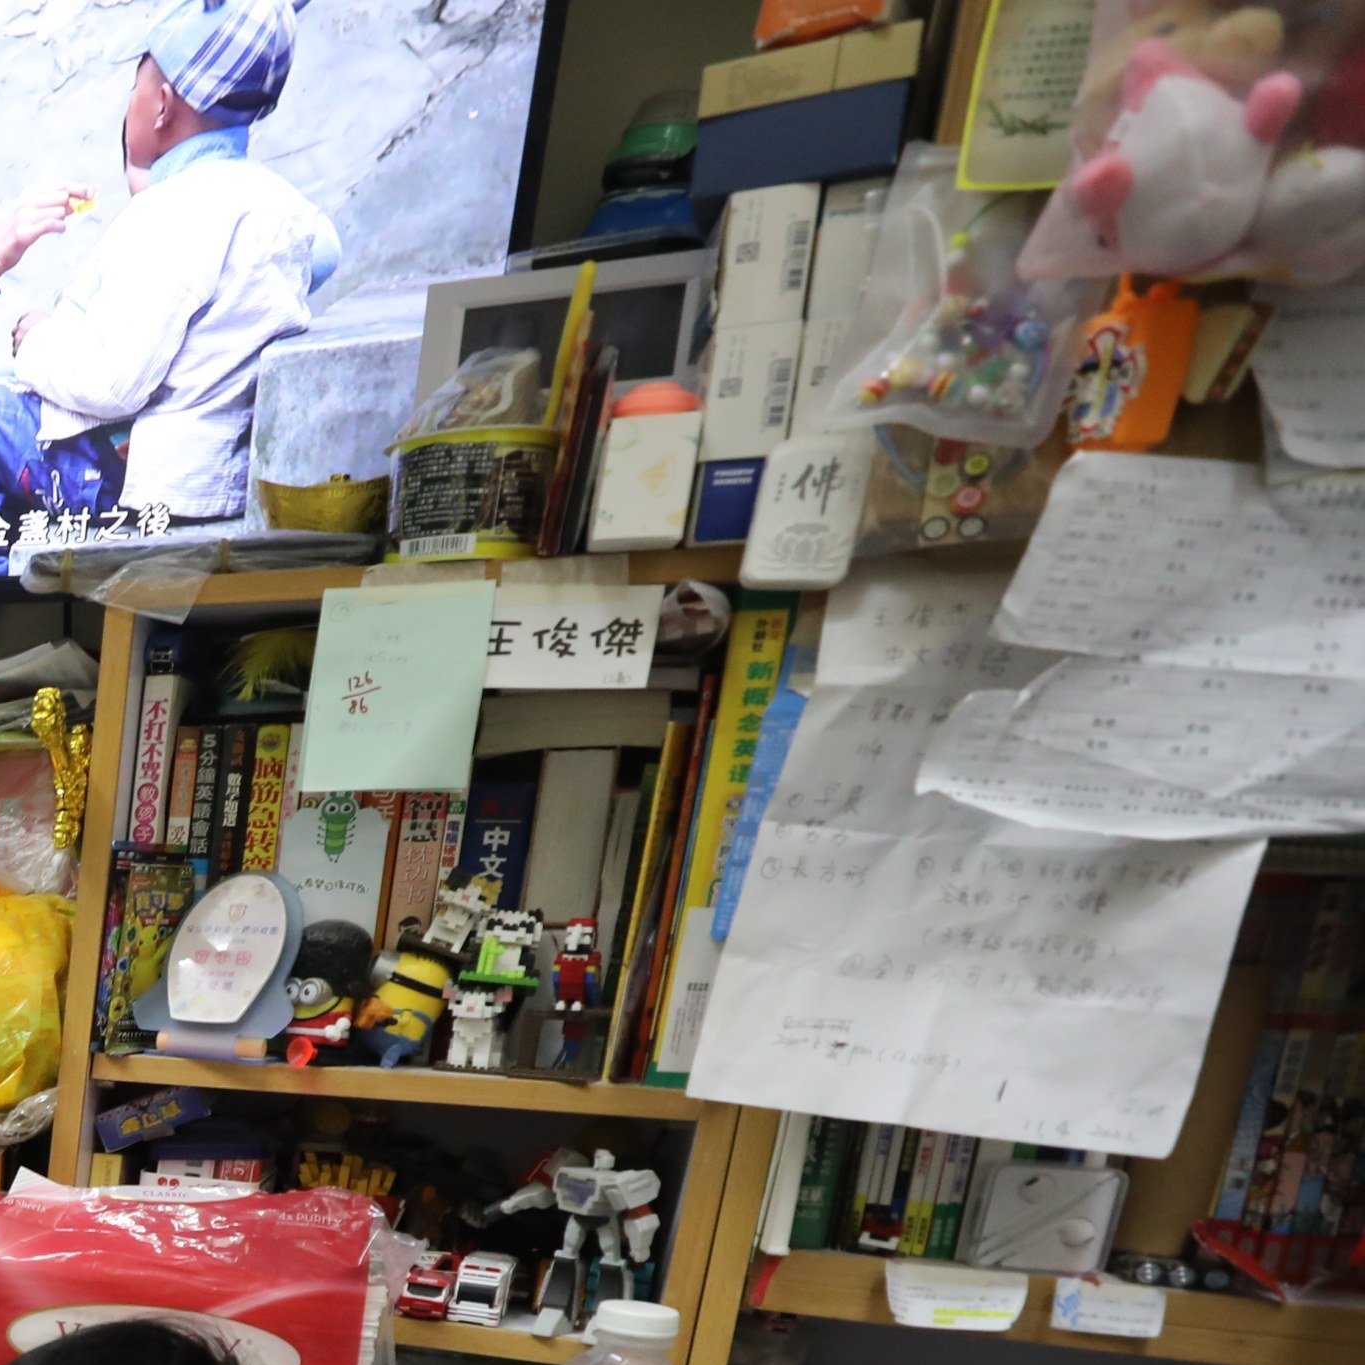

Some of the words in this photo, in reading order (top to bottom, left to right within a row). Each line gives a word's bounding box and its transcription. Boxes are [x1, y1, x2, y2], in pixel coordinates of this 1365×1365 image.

[791, 456, 843, 517] 佛
[487, 617, 645, 659] 王俊傑
[347, 671, 373, 692] 126
[348, 697, 368, 715] 86
[189, 733, 217, 854] 5分鐘英語會話
[478, 825, 511, 878] 中文
[142, 1190, 189, 1199] CLASSIC
[295, 1211, 343, 1226] PURITY
